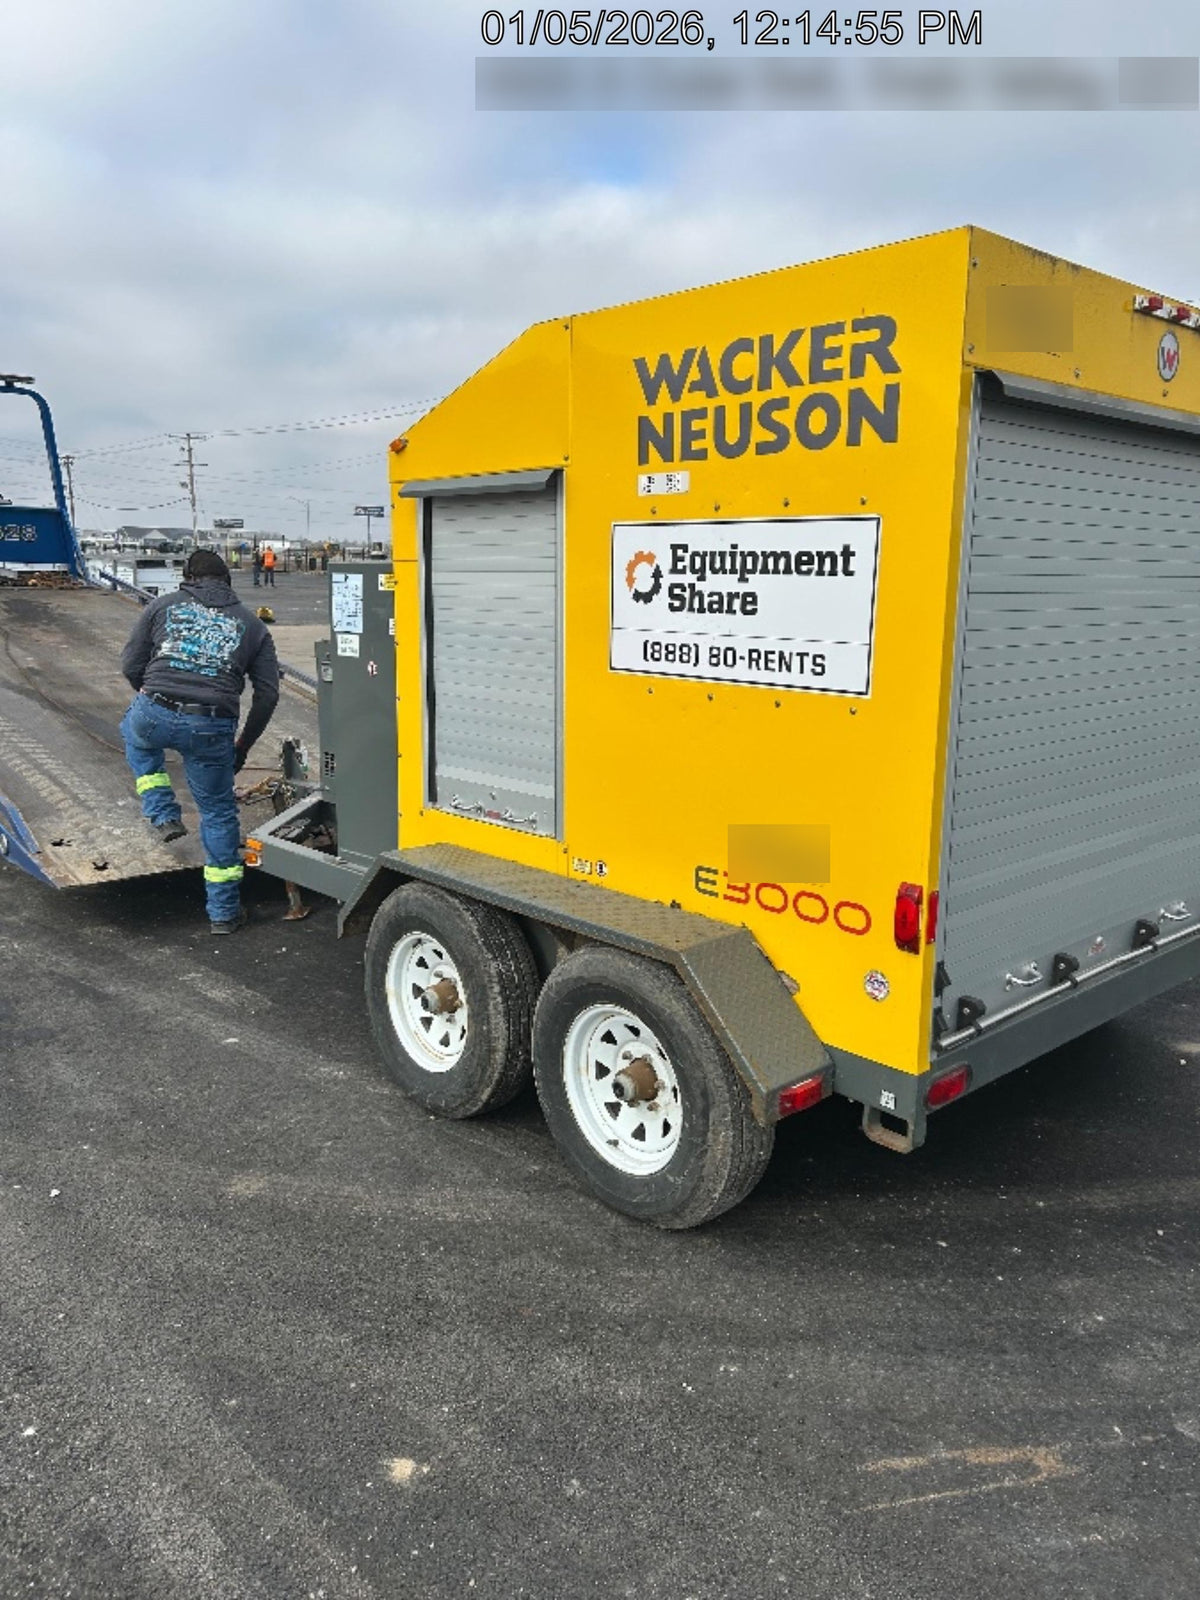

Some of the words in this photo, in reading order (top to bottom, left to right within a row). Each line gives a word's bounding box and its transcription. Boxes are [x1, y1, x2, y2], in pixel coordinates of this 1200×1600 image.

[632, 314, 902, 406] WACKER
[637, 382, 901, 466] NEUSON
[668, 543, 856, 584] Equipment
[667, 583, 759, 616] Share
[642, 639, 700, 667] (888)
[708, 646, 827, 677] 80-RENTS
